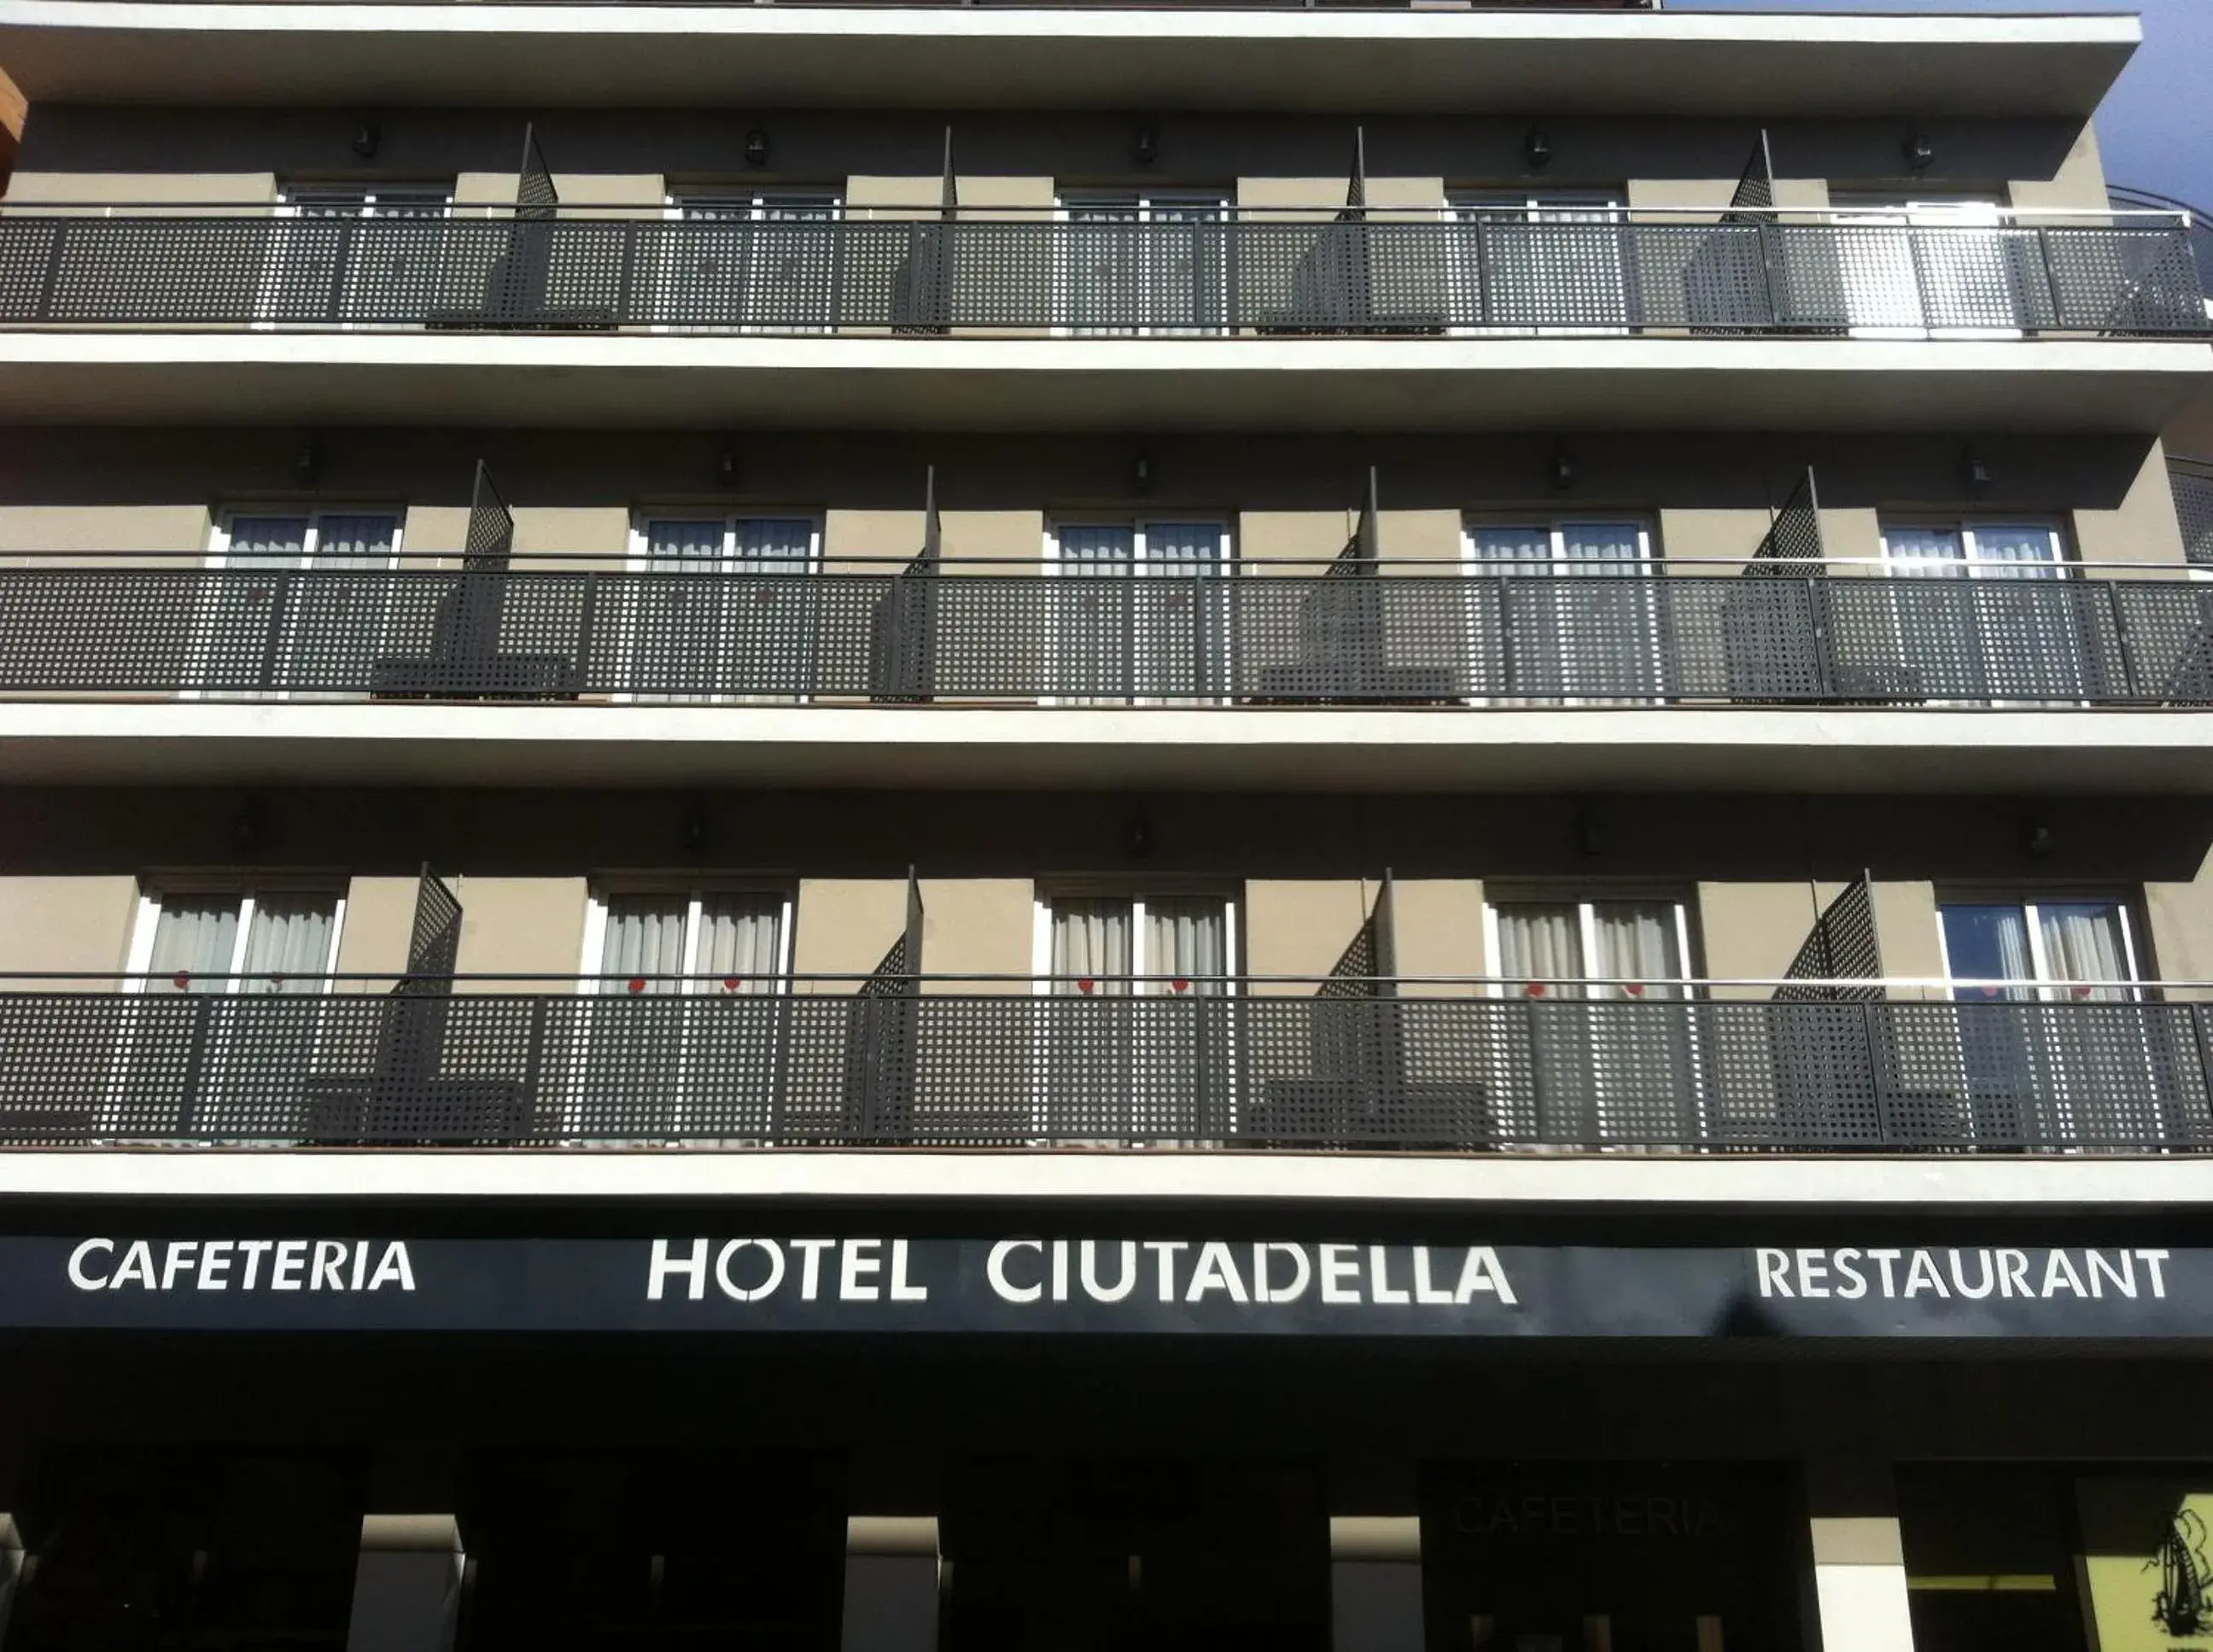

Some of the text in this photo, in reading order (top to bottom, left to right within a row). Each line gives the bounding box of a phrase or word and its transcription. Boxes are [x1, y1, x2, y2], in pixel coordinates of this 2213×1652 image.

[67, 1237, 417, 1291] CAFETERIA
[646, 1238, 1518, 1306] HOTEL CIUTADELLA
[1755, 1247, 2170, 1301] RESTAURANT
